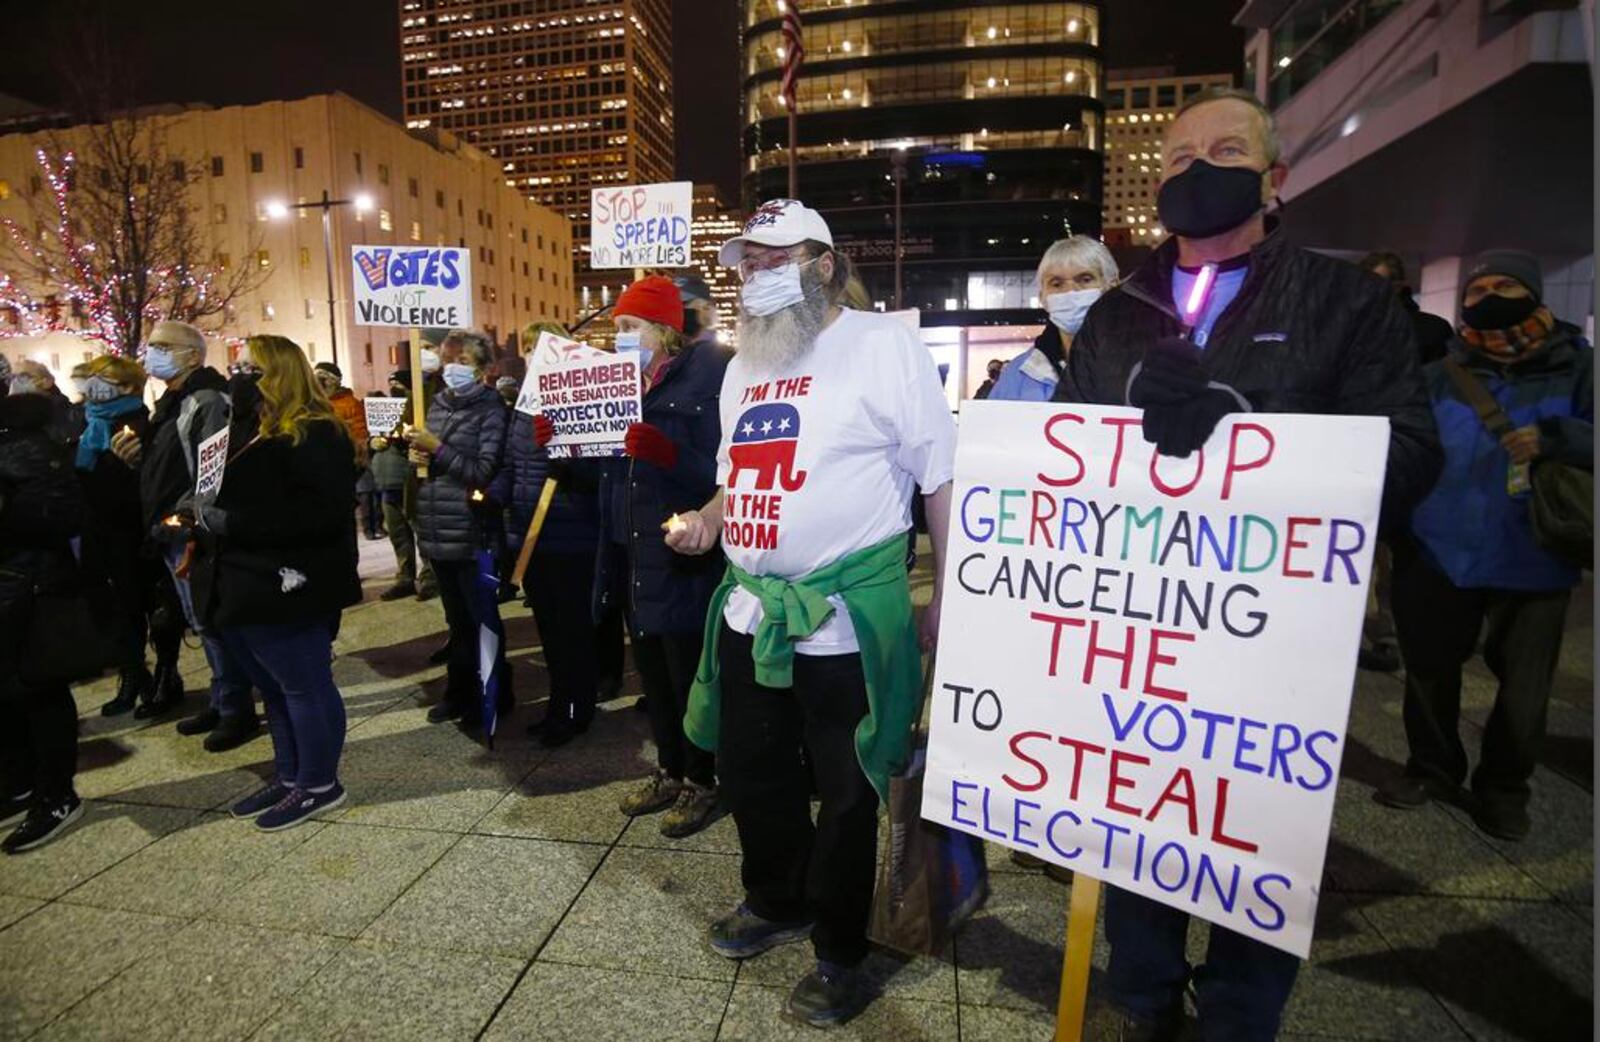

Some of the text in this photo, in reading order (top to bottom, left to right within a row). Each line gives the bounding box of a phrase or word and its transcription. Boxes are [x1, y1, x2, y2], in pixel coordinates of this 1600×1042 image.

[595, 188, 647, 224] STOP
[613, 216, 688, 249] SPREAD
[355, 248, 460, 291] VOTES
[656, 245, 686, 265] LIES
[358, 298, 459, 326] VIOLENCE
[391, 290, 426, 306] NOT
[538, 362, 636, 392] REMEMBER
[572, 383, 637, 402] SENATORS
[775, 376, 812, 399] THE
[541, 400, 638, 424] PROTECT OUR
[552, 422, 608, 436] EMOCRACY
[548, 444, 572, 459] JAN
[1037, 413, 1275, 500] STOP
[741, 494, 781, 520] THE
[961, 486, 1366, 585] GERRYMANDER
[958, 553, 1268, 638] CANCELING
[1030, 612, 1195, 700] THE
[943, 683, 1002, 731] TO
[1102, 694, 1338, 791] VOTERS
[1002, 731, 1258, 853] STEAL
[952, 781, 1291, 931] ELECTIONS
